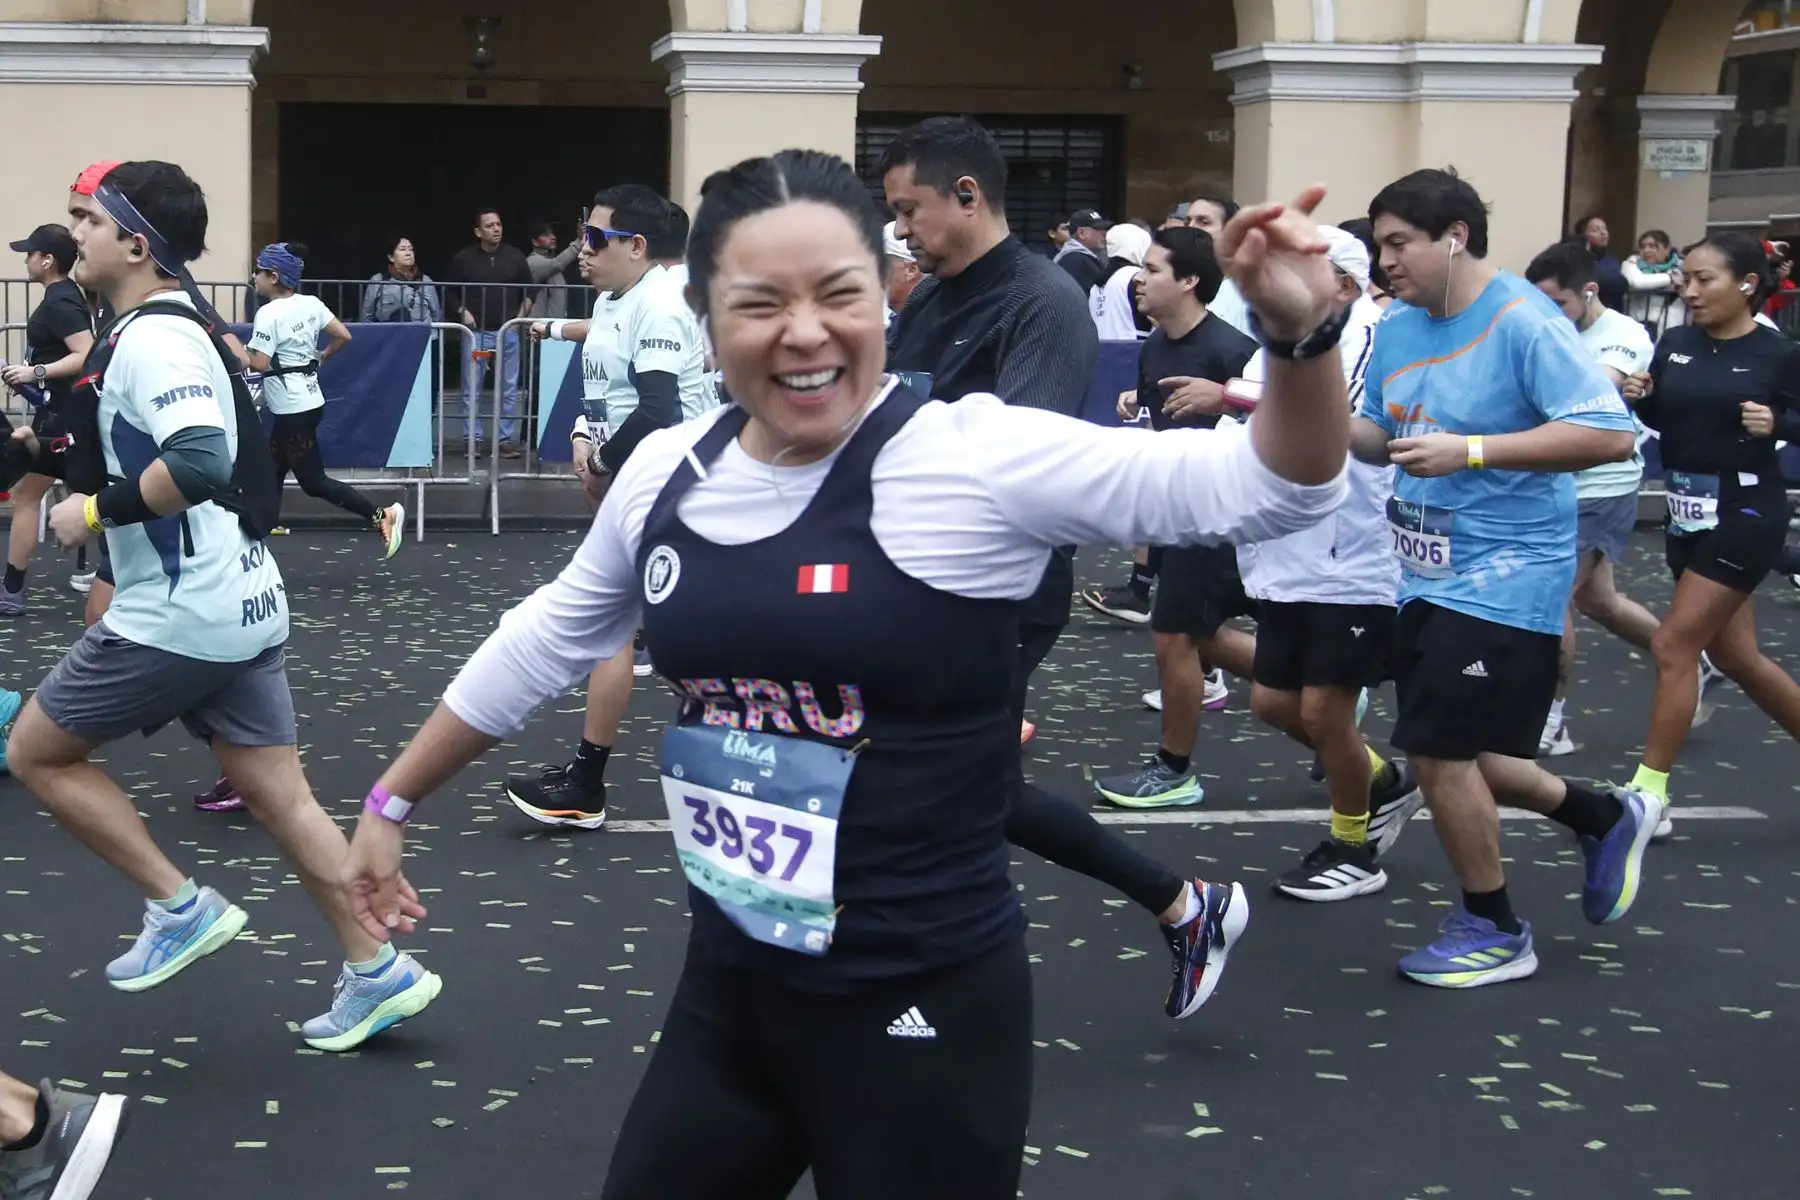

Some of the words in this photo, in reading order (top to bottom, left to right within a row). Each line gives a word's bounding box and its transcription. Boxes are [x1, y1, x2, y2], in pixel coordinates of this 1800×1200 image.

[290, 321, 305, 333] VISA
[639, 338, 681, 352] NITRO
[149, 384, 213, 413] NITRO
[1391, 528, 1443, 565] 7006
[241, 587, 278, 627] RUN
[731, 778, 755, 795] 21K
[683, 795, 812, 882] 3937
[886, 1025, 937, 1038] adidas
